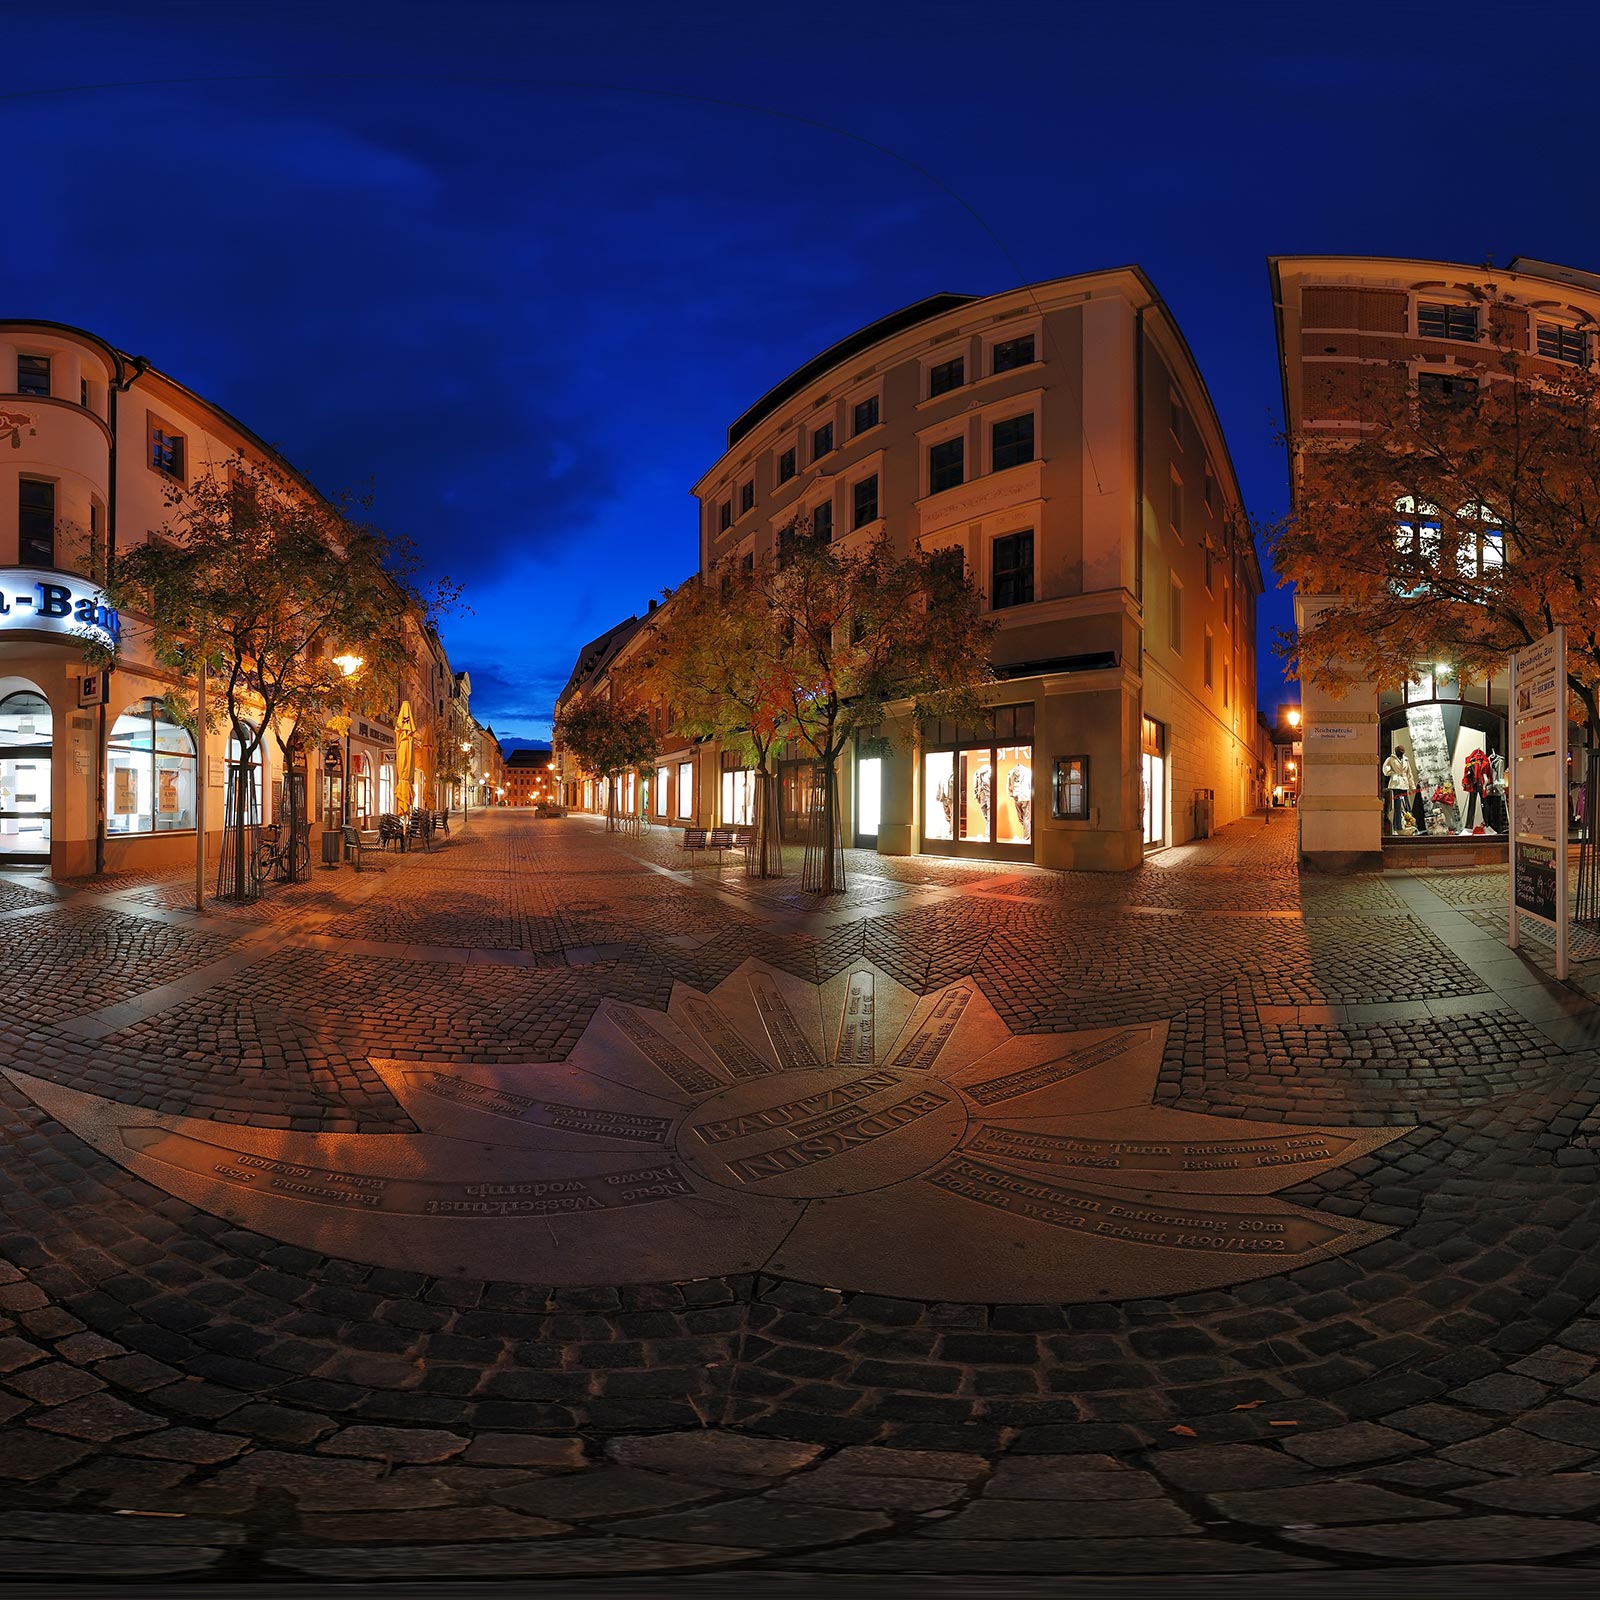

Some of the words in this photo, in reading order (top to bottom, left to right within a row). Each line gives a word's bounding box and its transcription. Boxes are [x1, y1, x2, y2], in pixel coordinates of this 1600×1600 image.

[706, 1072, 901, 1142] BAUTZEN
[967, 1139, 1055, 1161] Serbska
[1182, 1158, 1240, 1168] Erbaut
[979, 1128, 1102, 1152] Wendischer
[1108, 1143, 1171, 1156] Turm
[1182, 1141, 1278, 1157] Entfernung
[1283, 1136, 1326, 1149] 125m
[267, 1177, 380, 1205] Entfernung
[322, 1172, 386, 1190] Erbaut
[462, 1179, 588, 1197] wodarnja
[603, 1166, 677, 1188] Nowa
[424, 1194, 605, 1214] Wasserkunst
[948, 1160, 1104, 1212] Reichenturm
[1105, 1205, 1227, 1231] Entfernung
[1237, 1218, 1285, 1232] 80m
[928, 1170, 1016, 1207] Bohata
[1092, 1221, 1168, 1243] Erbaut
[1172, 1233, 1286, 1251] 1490/1492
